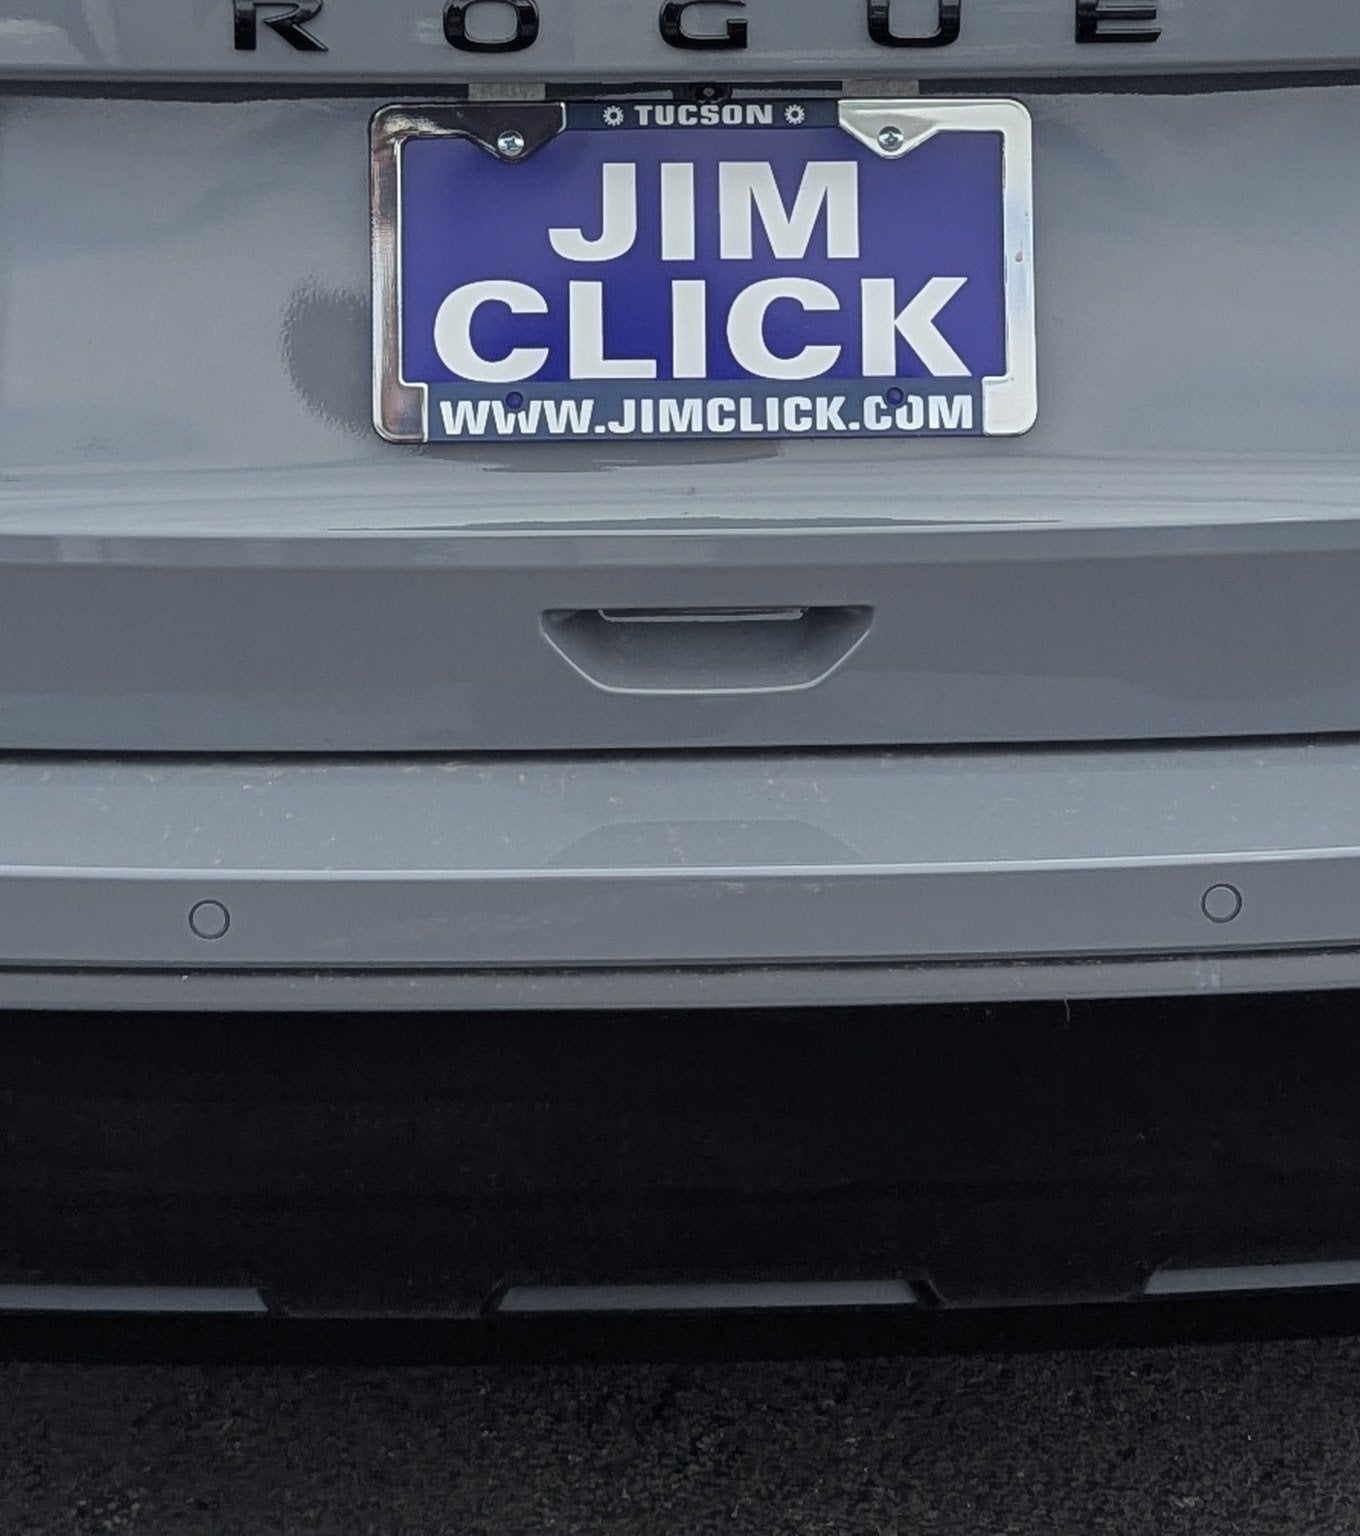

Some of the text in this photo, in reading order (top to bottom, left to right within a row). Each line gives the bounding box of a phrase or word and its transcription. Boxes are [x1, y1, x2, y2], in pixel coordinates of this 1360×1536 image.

[634, 104, 773, 126] TUCSON
[548, 161, 860, 262] JIM
[433, 277, 972, 383] CLICK
[440, 395, 974, 436] WWW.JIMCLICK.COM
